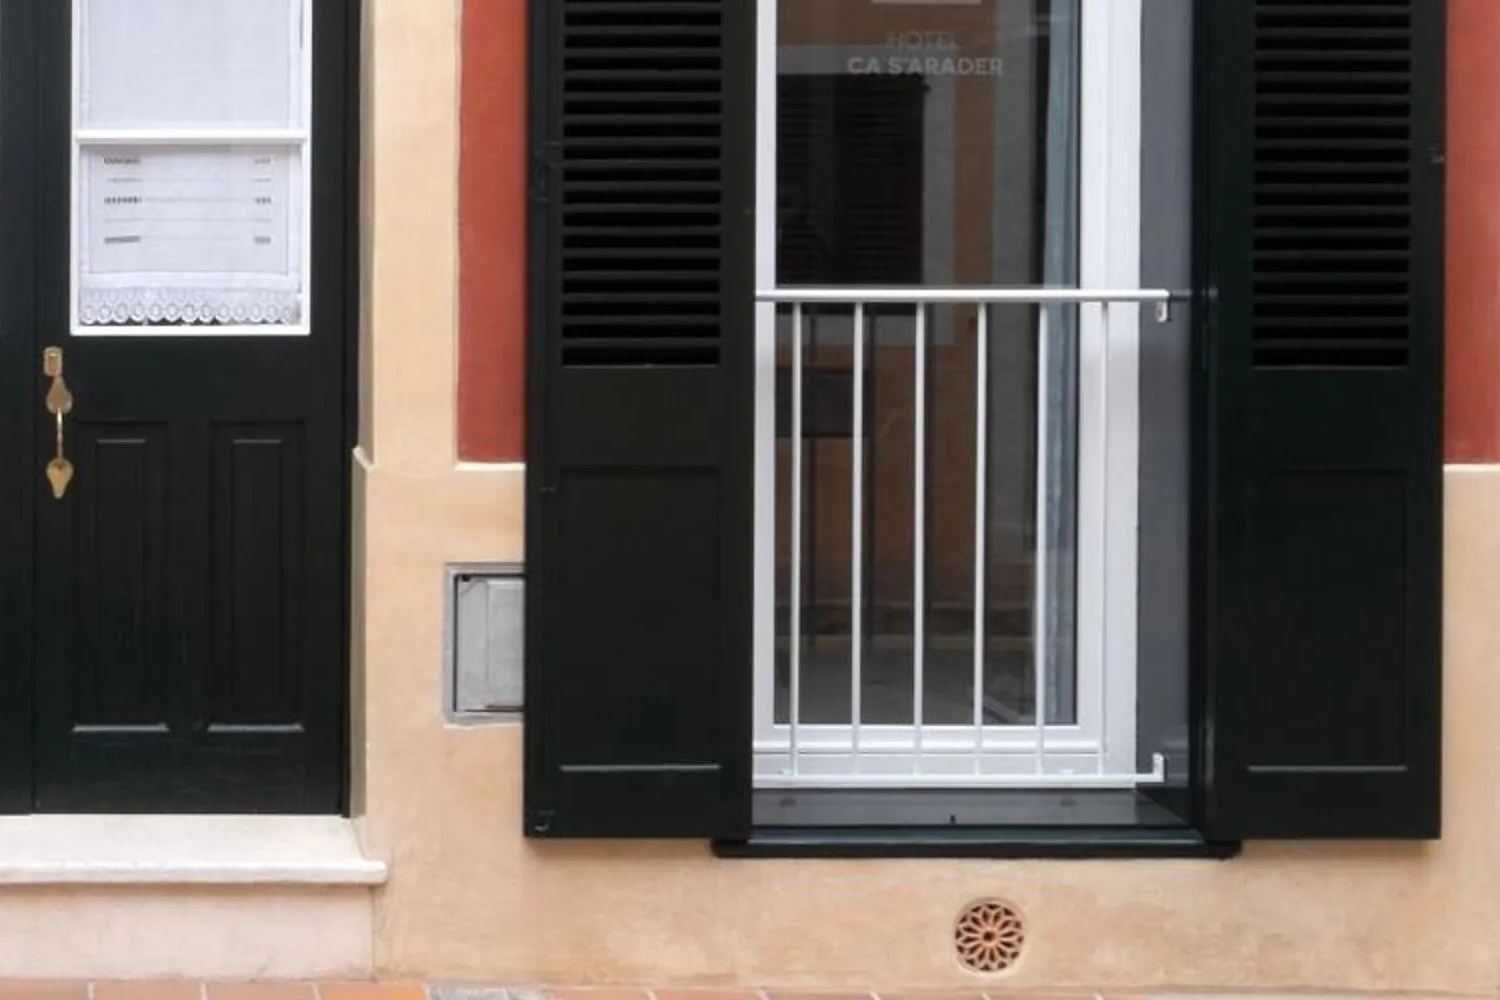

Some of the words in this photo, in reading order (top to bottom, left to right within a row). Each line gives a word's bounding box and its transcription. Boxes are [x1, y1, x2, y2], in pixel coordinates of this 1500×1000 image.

[886, 31, 961, 50] HOTEL
[847, 56, 881, 75] CA
[887, 56, 1004, 75] S'ARADER
